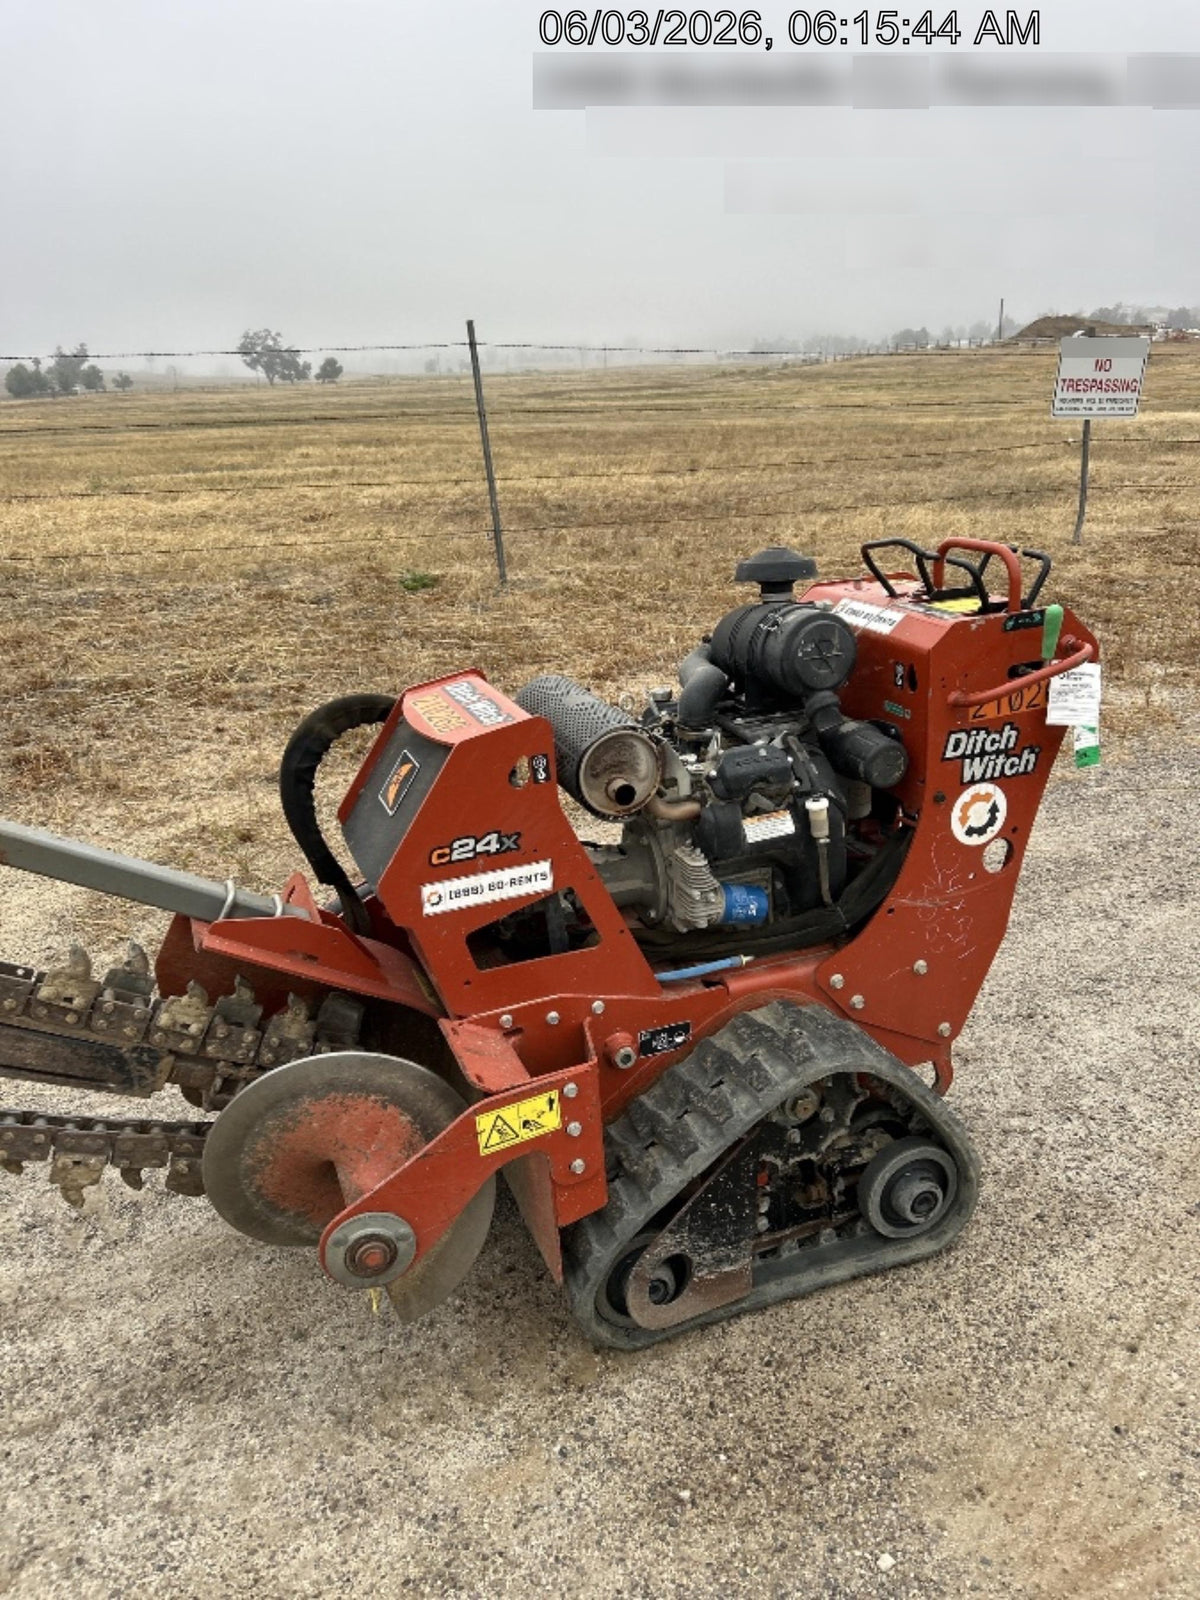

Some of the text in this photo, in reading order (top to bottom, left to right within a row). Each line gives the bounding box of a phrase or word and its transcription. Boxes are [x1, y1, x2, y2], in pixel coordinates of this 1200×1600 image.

[1094, 358, 1112, 372] NO
[1060, 378, 1139, 393] TRESPASSING
[944, 724, 1018, 758] Ditch
[963, 748, 1036, 783] Witch
